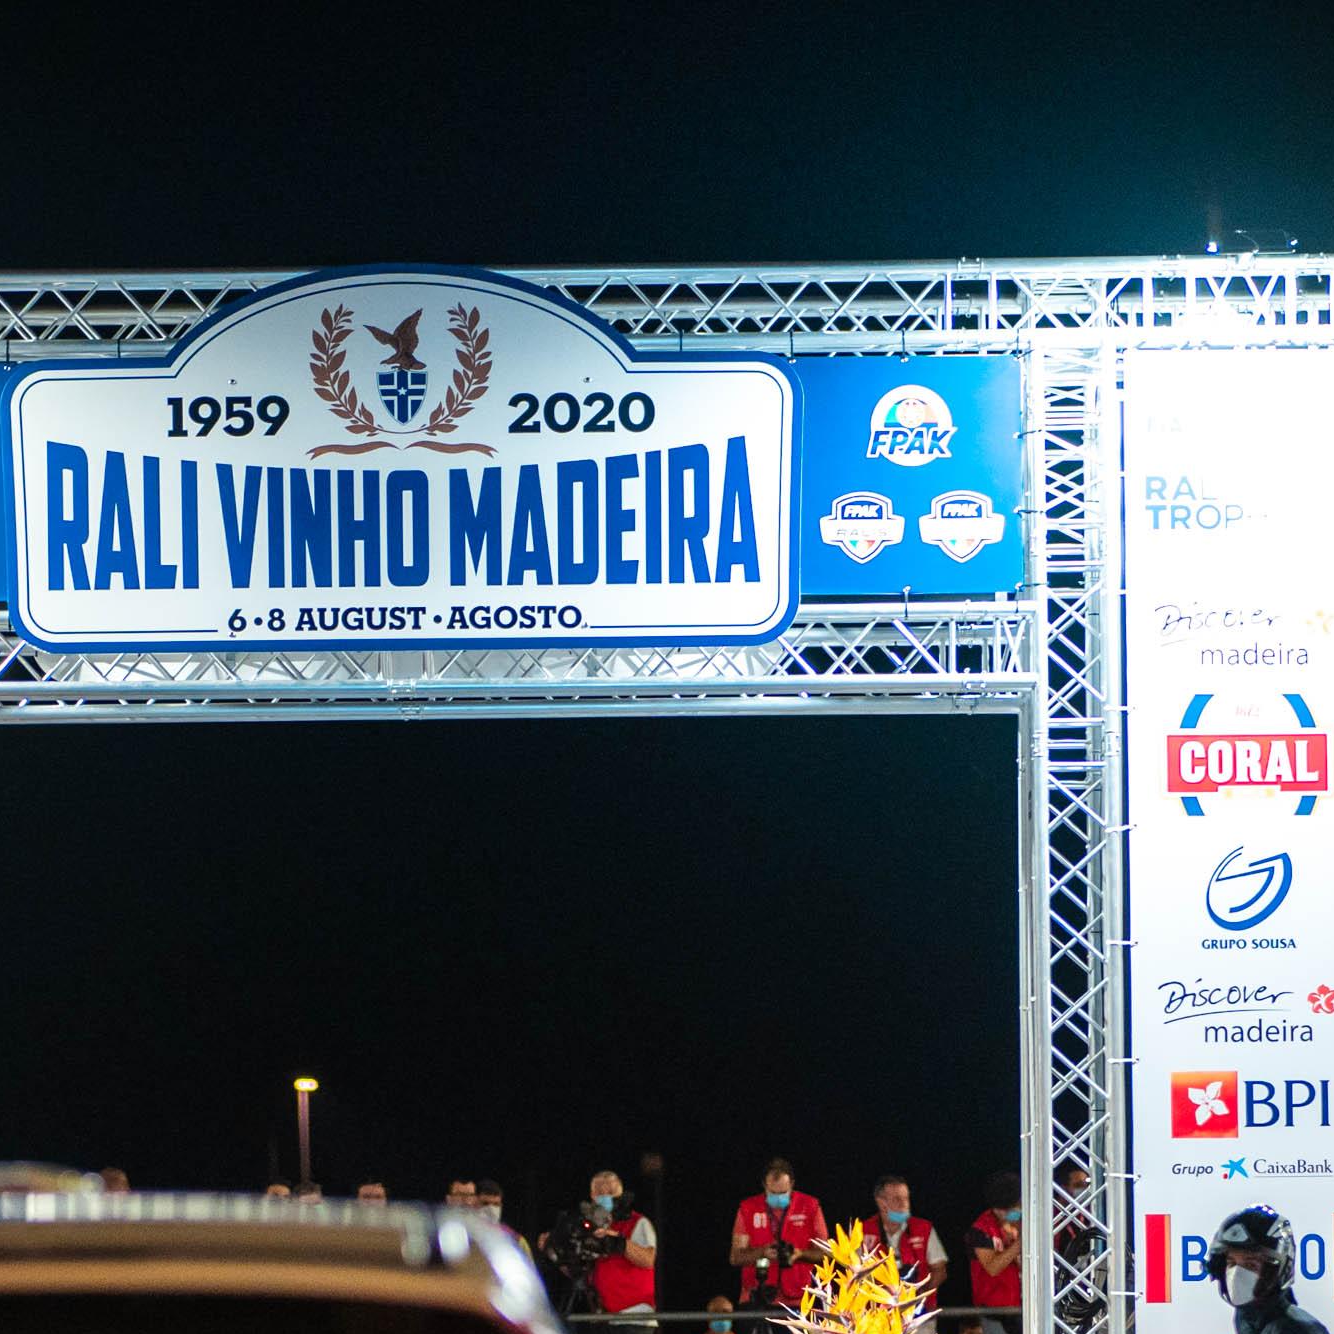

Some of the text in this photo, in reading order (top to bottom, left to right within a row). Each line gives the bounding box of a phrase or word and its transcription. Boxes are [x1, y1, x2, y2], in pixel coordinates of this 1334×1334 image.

[167, 391, 655, 437] 1959 2020
[870, 430, 951, 455] FPAK
[1146, 476, 1219, 500] RAL
[47, 435, 761, 591] RALI VINHO MADEIRA
[1145, 504, 1245, 529] TROP
[294, 606, 426, 631] AUGUST
[446, 605, 583, 630] AGOSTO
[1201, 643, 1310, 666] madeira
[1179, 739, 1319, 783] CORAL
[1202, 938, 1296, 950] GRUPO SOUSA
[1158, 978, 1294, 1014] Discover
[1204, 1020, 1314, 1043] madeira
[1244, 1079, 1331, 1128] BPI
[1172, 1159, 1333, 1177] Grupo CaixaBank
